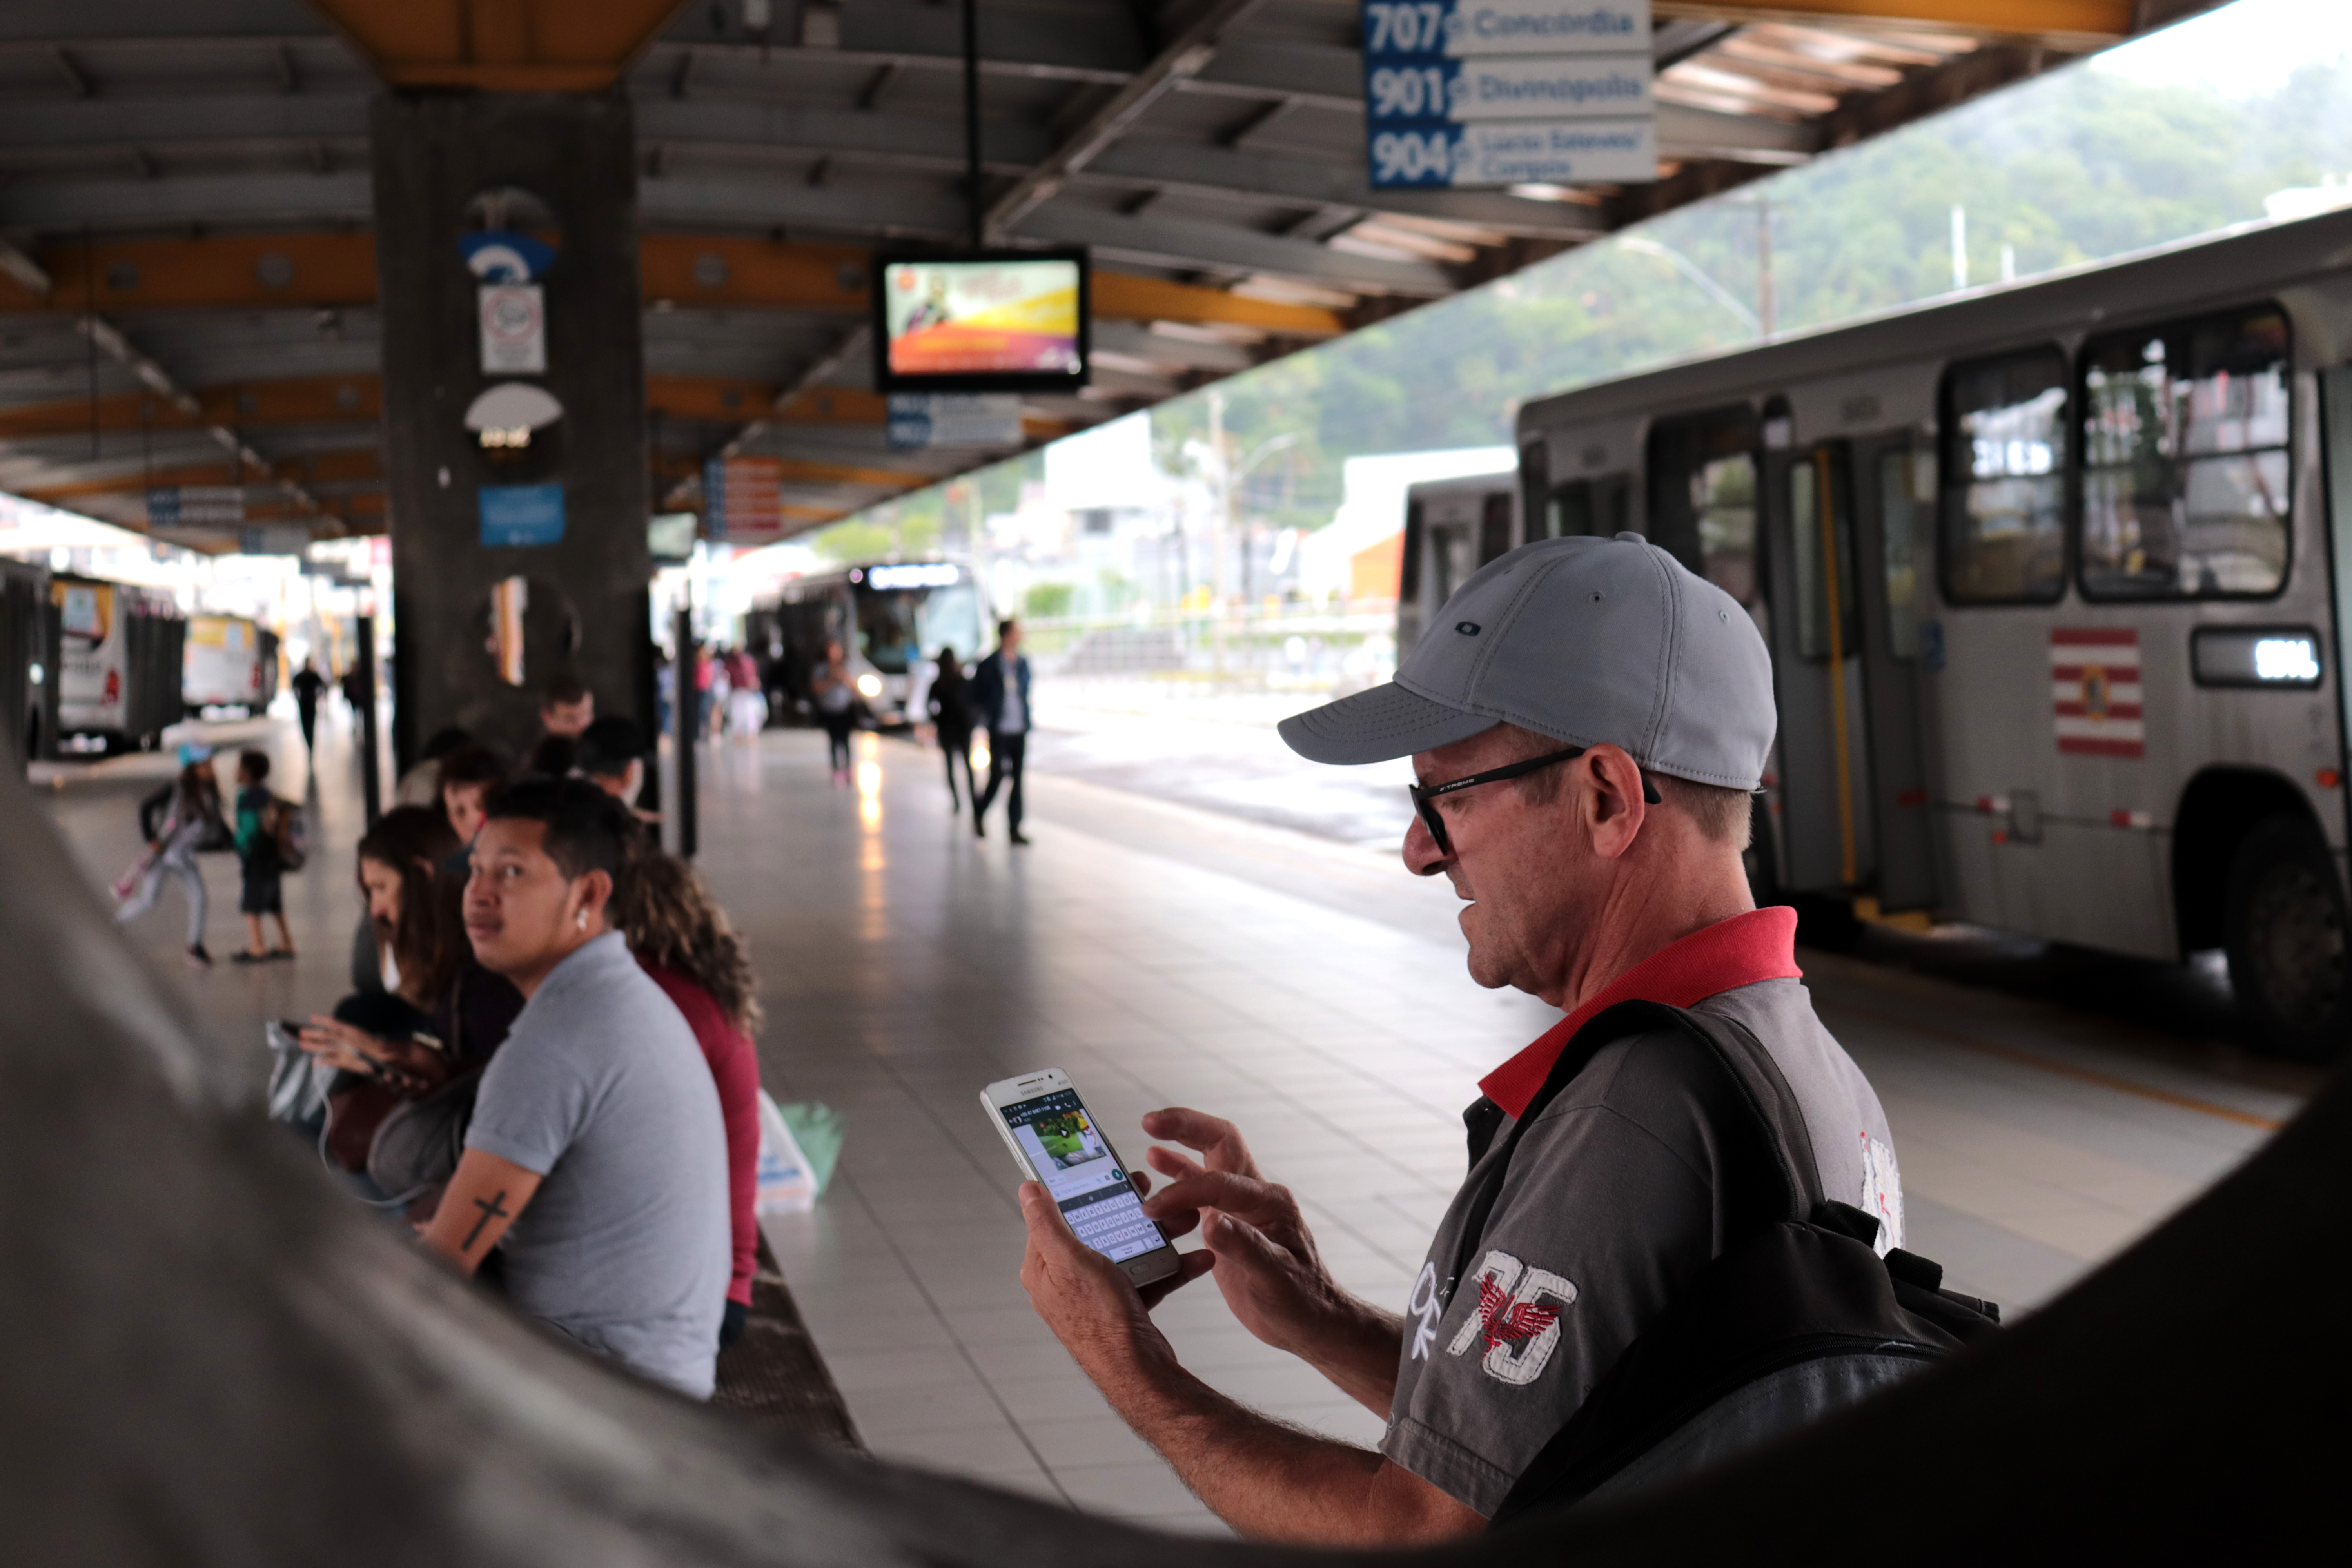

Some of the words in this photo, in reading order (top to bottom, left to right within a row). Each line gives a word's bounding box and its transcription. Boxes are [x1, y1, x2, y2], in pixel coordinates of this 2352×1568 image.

[1367, 3, 1442, 52] 707
[1372, 68, 1444, 115] 901
[1374, 132, 1449, 182] 904
[1021, 1086, 1043, 1096] SAMSUNG
